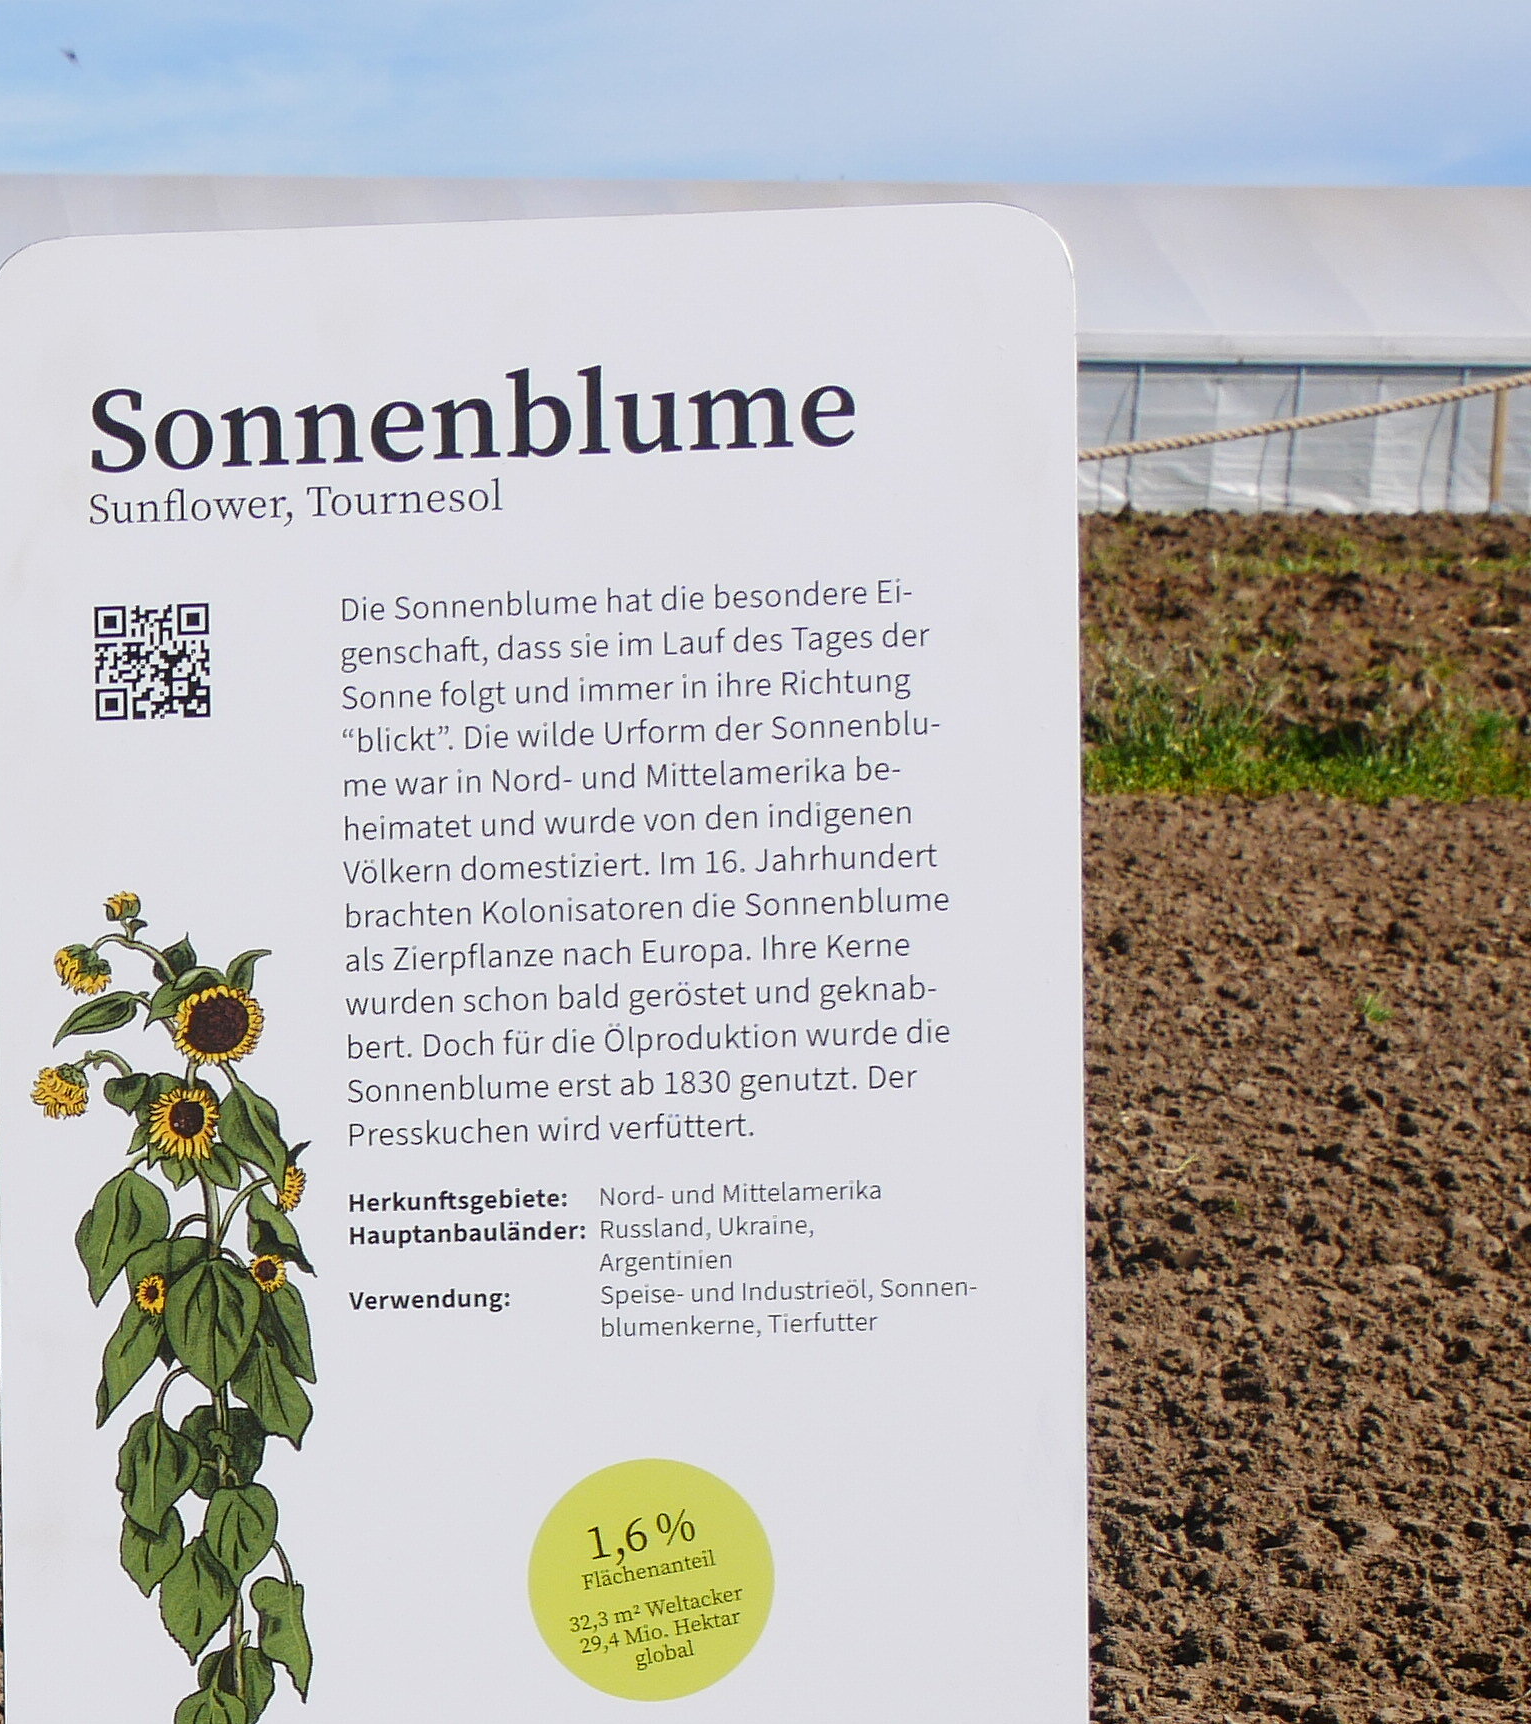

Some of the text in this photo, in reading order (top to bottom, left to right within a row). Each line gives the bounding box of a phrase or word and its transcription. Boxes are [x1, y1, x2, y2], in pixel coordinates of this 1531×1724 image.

[90, 364, 856, 474] Sonnenblume
[89, 476, 504, 528] Sunflower, Tournesol
[341, 577, 913, 623] Die Sonnenblume hat die besondere Ei-
[340, 621, 931, 674] genschaft, dass sie im Lauf des Tages der
[341, 667, 912, 714] Sonne folgt und immer in ihre Richtung
[464, 723, 509, 750] Die
[516, 720, 595, 748] wilde
[604, 717, 706, 746] Urform
[714, 715, 764, 743] der
[770, 709, 941, 741] Sonnenblu-
[343, 754, 901, 798] me war in Nord- und Mittelamerika be-
[344, 800, 912, 842] heimatet und wurde von den indigenen
[342, 842, 939, 886] Völkern domestiziert. Im 16. Jahrhundert
[345, 886, 950, 929] brachten Kolonisatoren die Sonnenblume
[345, 933, 911, 977] als Zierpflanze nach Europa. Ihre Kerne
[344, 973, 938, 1016] wurden schon bald geröstet und geknab-
[347, 1017, 951, 1060] bert. Doch für die Ölproduktion wurde die
[347, 1065, 918, 1104] Sonnenblume erst ab 1830 genutzt. Der
[348, 1112, 755, 1148] Presskuchen wird verfüttert.
[348, 1187, 568, 1216] Herkunftsgebiete:
[599, 1179, 882, 1207] Nord- und Mittelamerika
[349, 1220, 586, 1250] Hauptanbauländer:
[600, 1214, 814, 1242] Russland, Ukraine,
[599, 1249, 733, 1278] Argentinien
[348, 1287, 511, 1313] Verwendung:
[600, 1277, 978, 1310] Speise- und Industrieöl, Sonnen-
[601, 1311, 879, 1339] blumenkerne, Tierfutter
[587, 1509, 695, 1566] 1,6 %
[581, 1549, 716, 1591] Flächenanteil
[569, 1587, 743, 1633] 32,3 m² Weltacker
[579, 1612, 741, 1654] 29,4 Mio. Hektar
[635, 1640, 694, 1671] global
